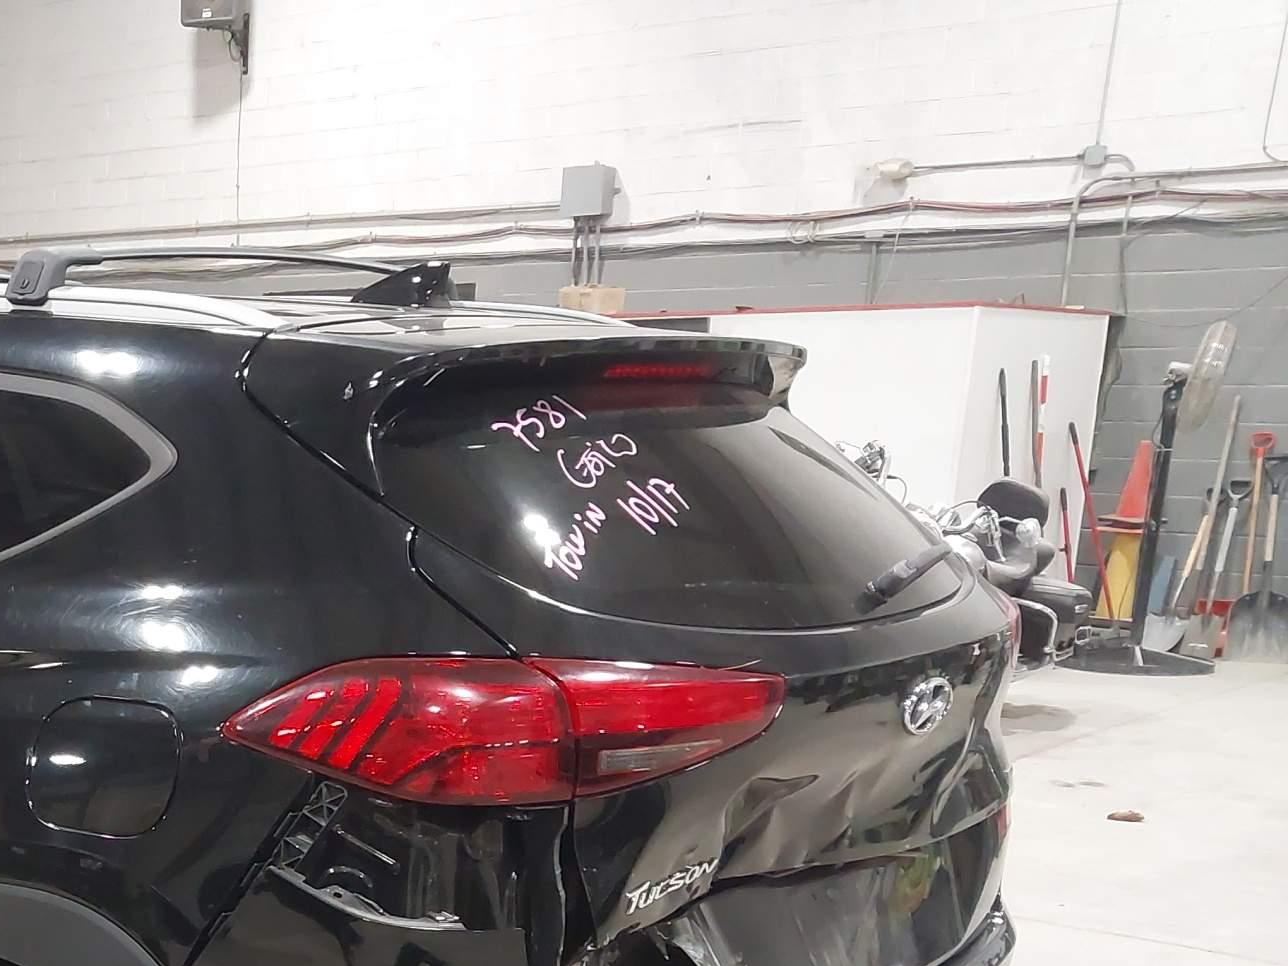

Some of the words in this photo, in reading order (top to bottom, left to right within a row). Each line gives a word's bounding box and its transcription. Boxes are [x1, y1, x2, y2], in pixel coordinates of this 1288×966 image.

[491, 395, 587, 452] 7581
[616, 478, 690, 535] 10/17
[625, 858, 719, 915] TUCSON
